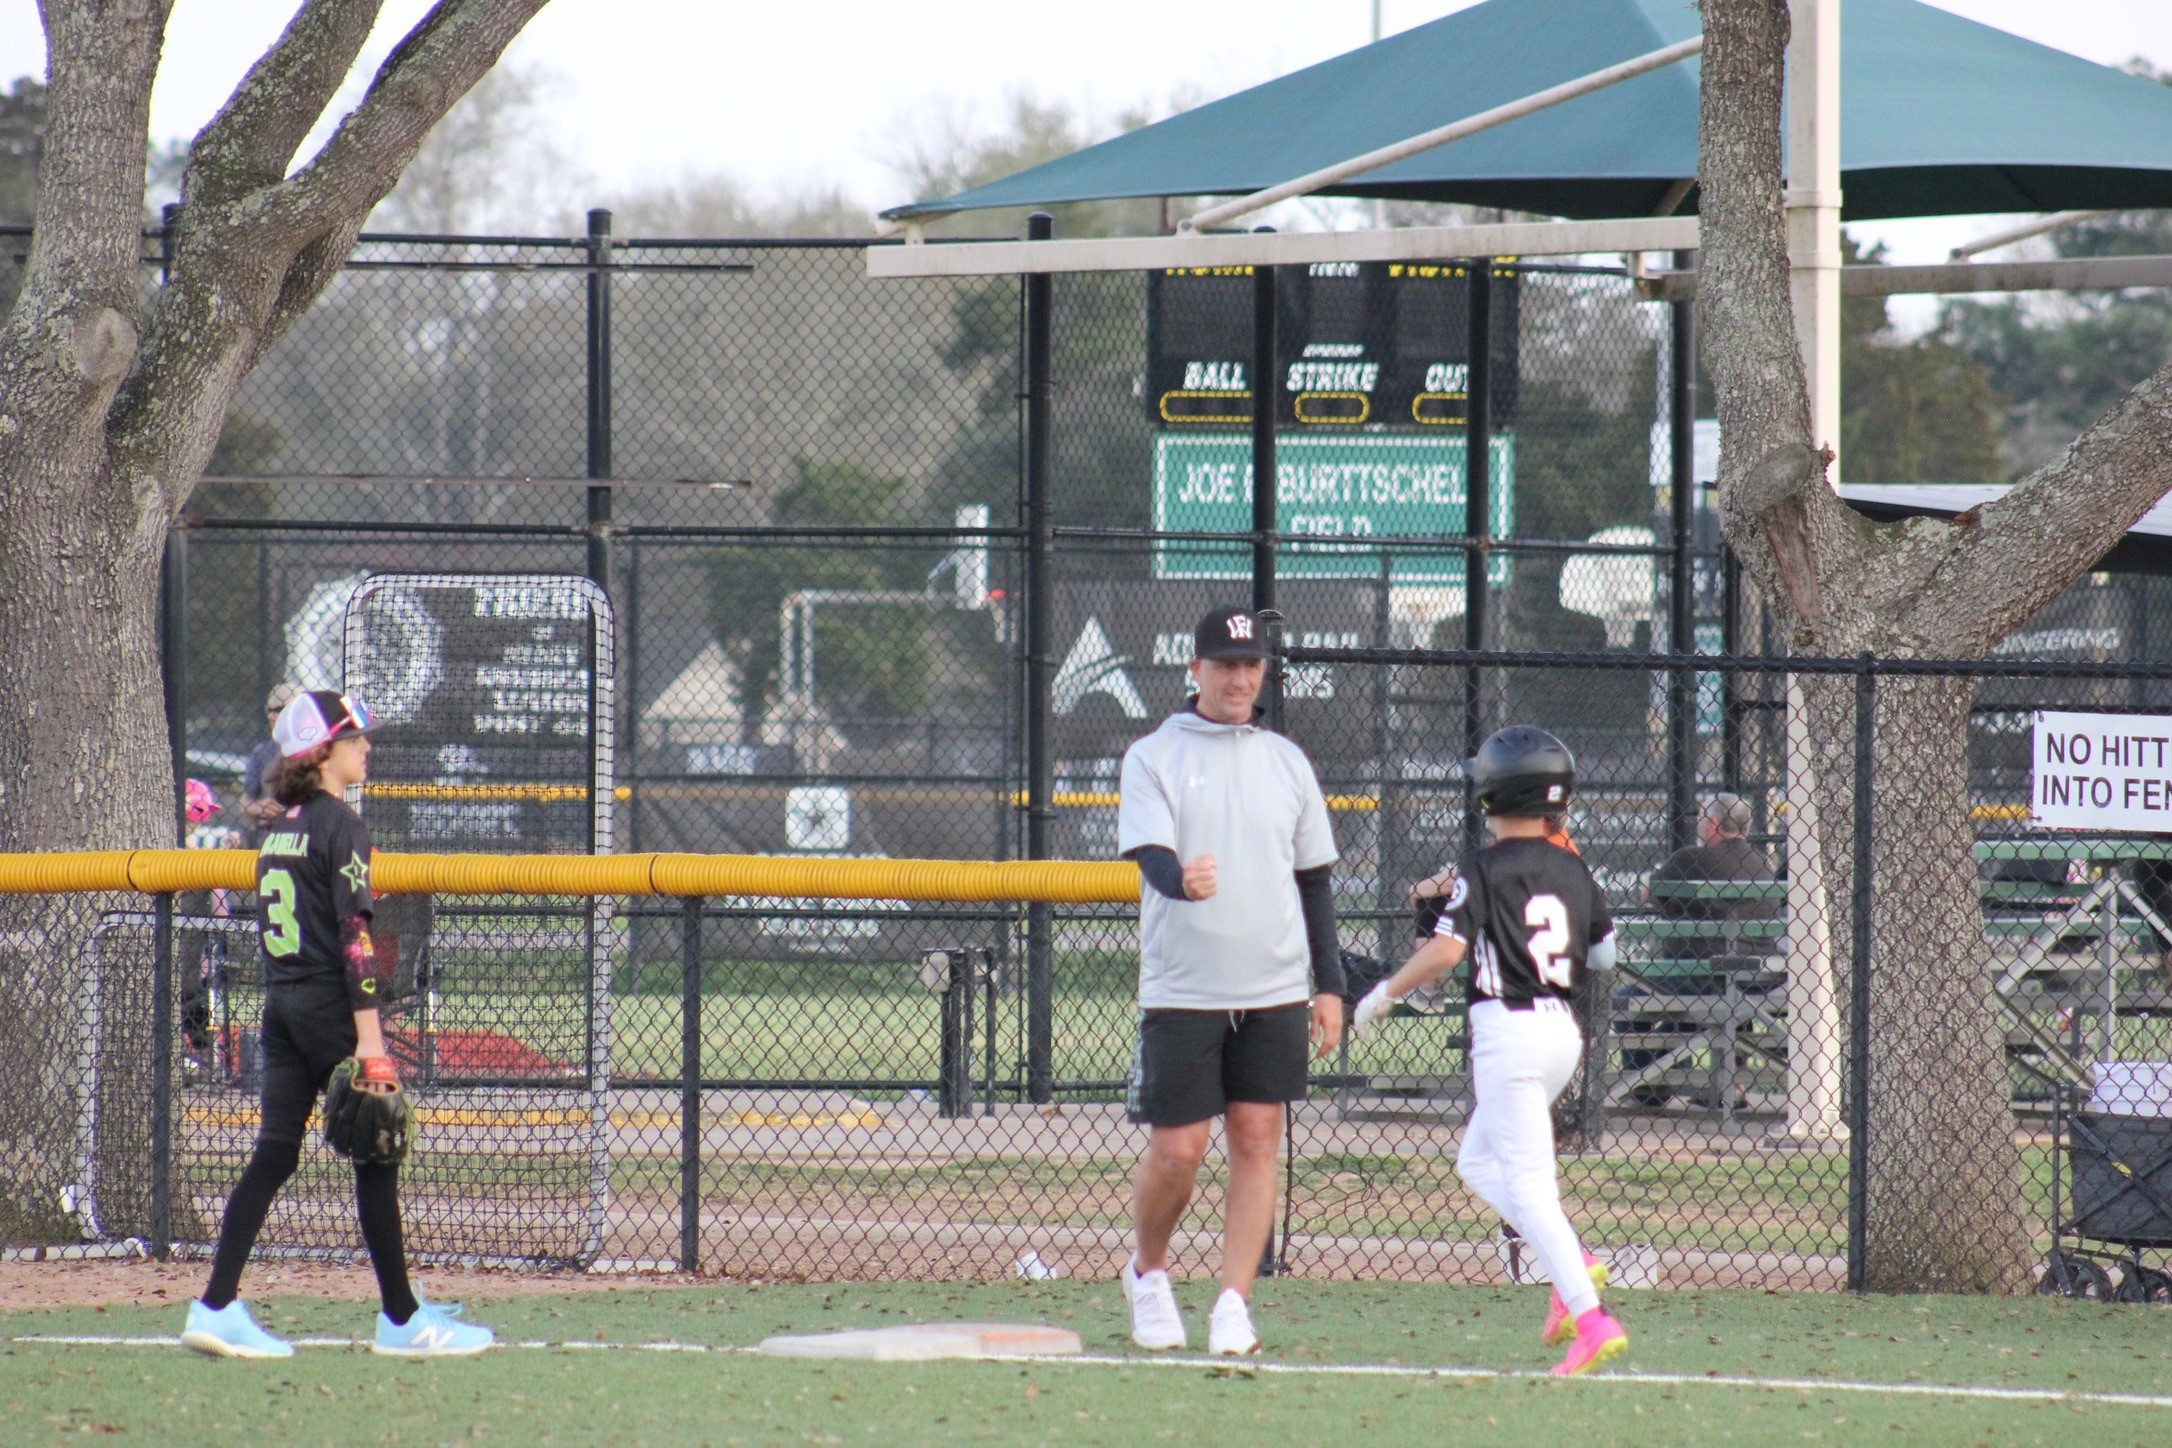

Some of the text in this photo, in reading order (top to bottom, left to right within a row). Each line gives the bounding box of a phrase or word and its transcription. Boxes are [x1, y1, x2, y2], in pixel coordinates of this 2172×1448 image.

[1184, 361, 1246, 391] BALL
[1286, 362, 1379, 391] STRIKE
[1179, 463, 1236, 503] JOE
[2047, 732, 2170, 768] NO HITT
[2042, 774, 2113, 808] INTO
[260, 868, 300, 958] 3
[1525, 894, 1572, 988] 2
